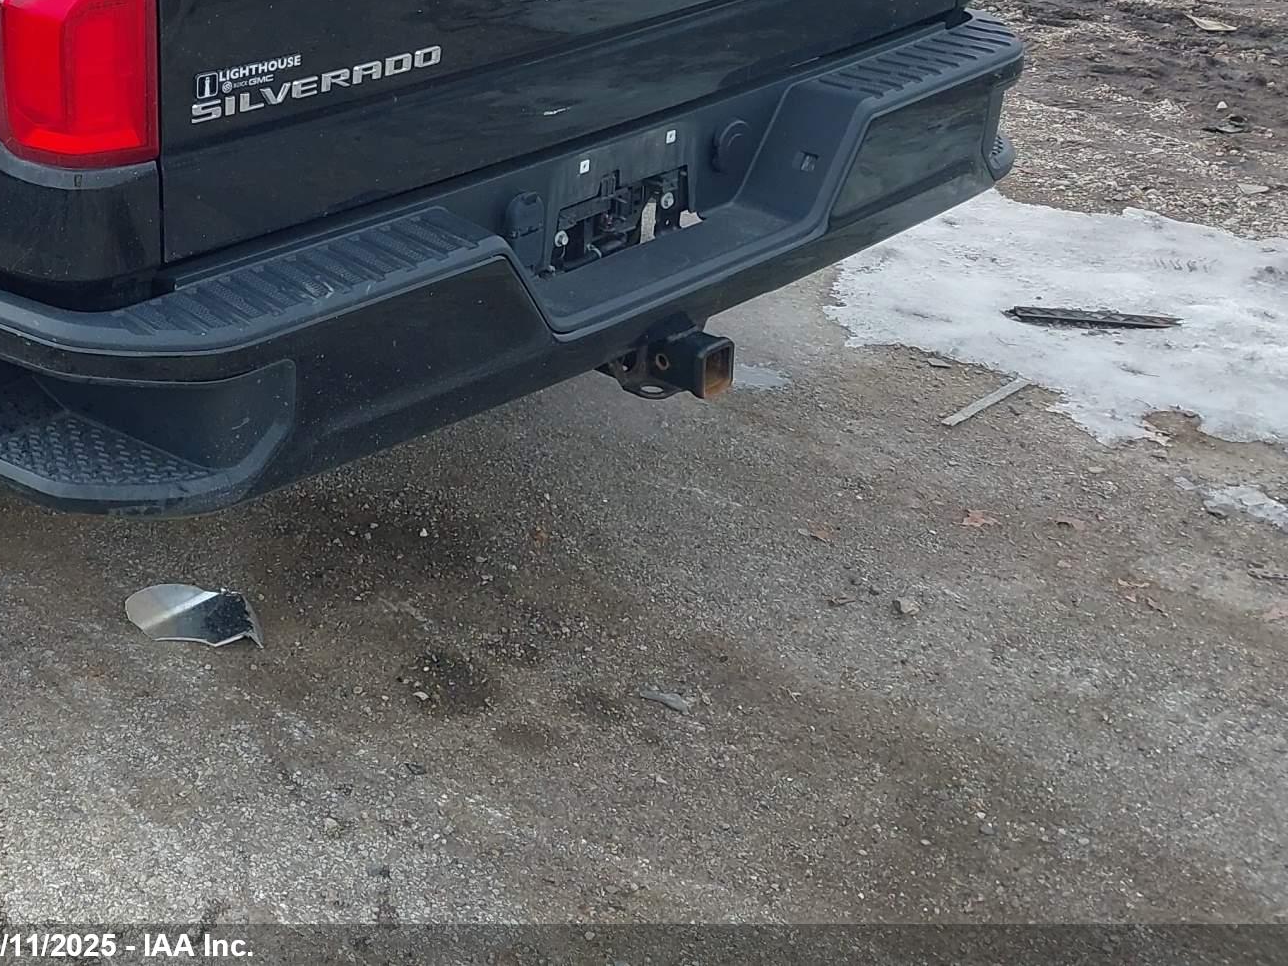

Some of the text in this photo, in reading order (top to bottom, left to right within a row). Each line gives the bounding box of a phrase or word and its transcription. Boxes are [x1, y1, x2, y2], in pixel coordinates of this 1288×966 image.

[219, 55, 302, 82] LIGHTHOUSE
[248, 74, 274, 86] GMC
[191, 45, 442, 124] SILVERADO
